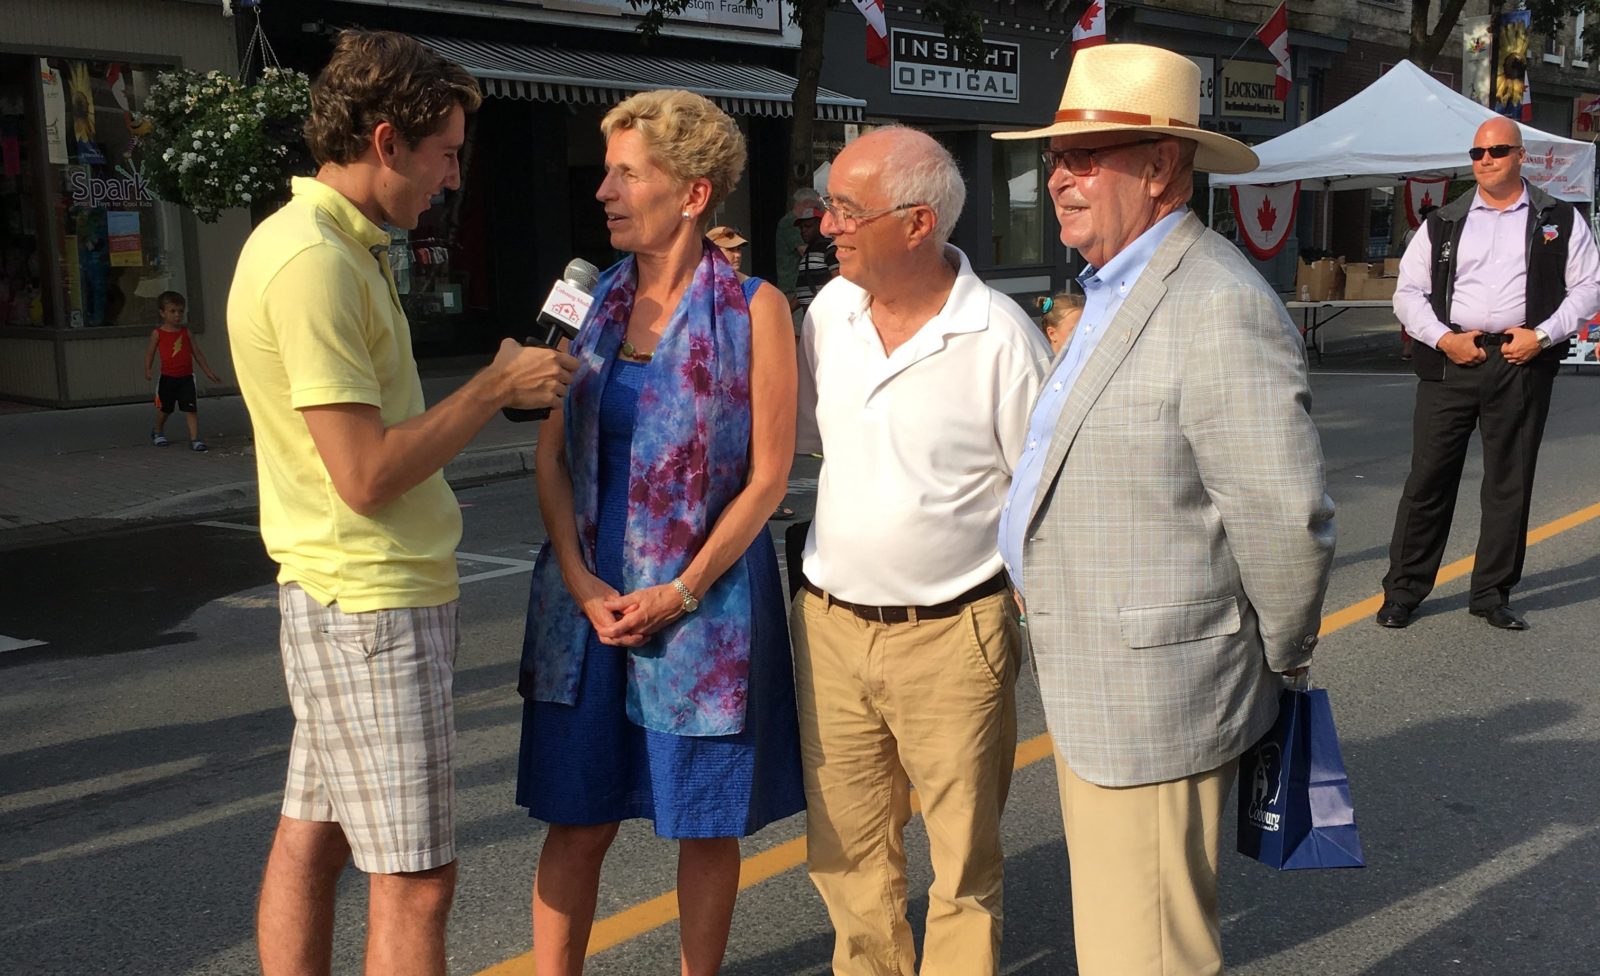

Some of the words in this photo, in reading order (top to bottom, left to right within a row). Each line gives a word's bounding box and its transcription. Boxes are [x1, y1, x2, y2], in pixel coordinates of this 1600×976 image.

[688, 0, 715, 11] stom
[899, 66, 1014, 94] OPTICAL
[1224, 76, 1276, 100] LOCKSMIT
[71, 172, 152, 208] Spark
[97, 199, 111, 208] Toys
[112, 199, 121, 207] for
[122, 199, 138, 207] Cool
[139, 199, 153, 207] Kids
[1248, 800, 1280, 831] Cobourg
